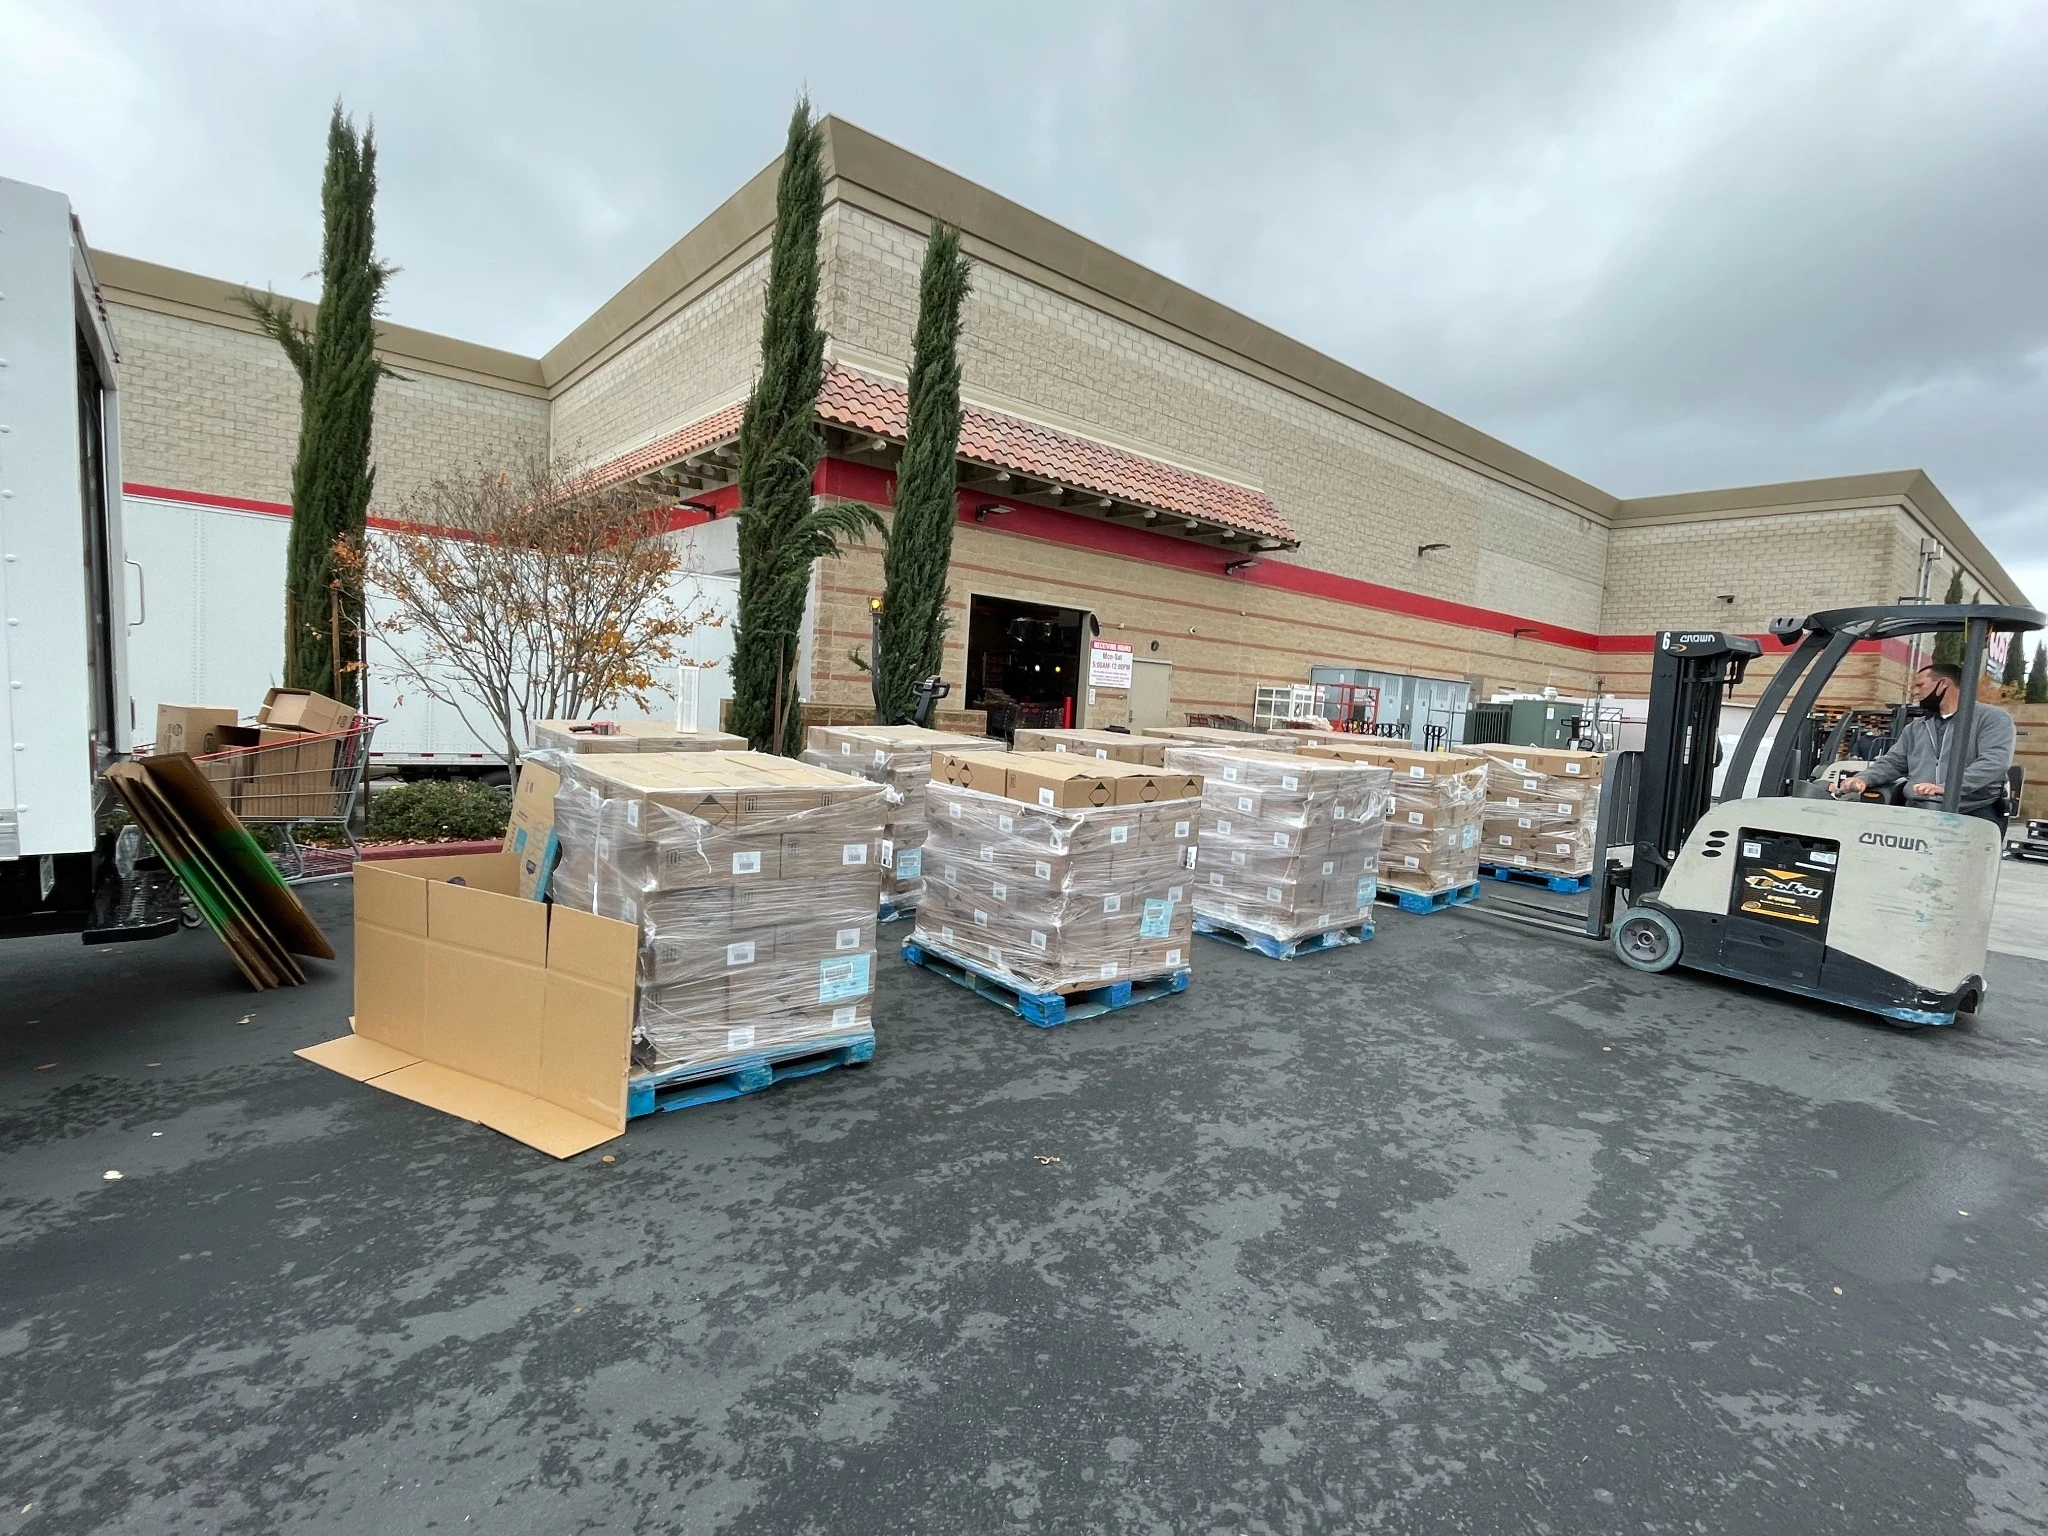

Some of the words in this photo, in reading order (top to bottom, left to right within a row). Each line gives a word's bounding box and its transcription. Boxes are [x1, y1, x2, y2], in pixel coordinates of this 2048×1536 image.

[1662, 632, 1671, 650] 6
[1680, 634, 1715, 643] CROWN
[1103, 652, 1122, 660] Mon-Sat
[1859, 832, 1929, 852] CROWN
